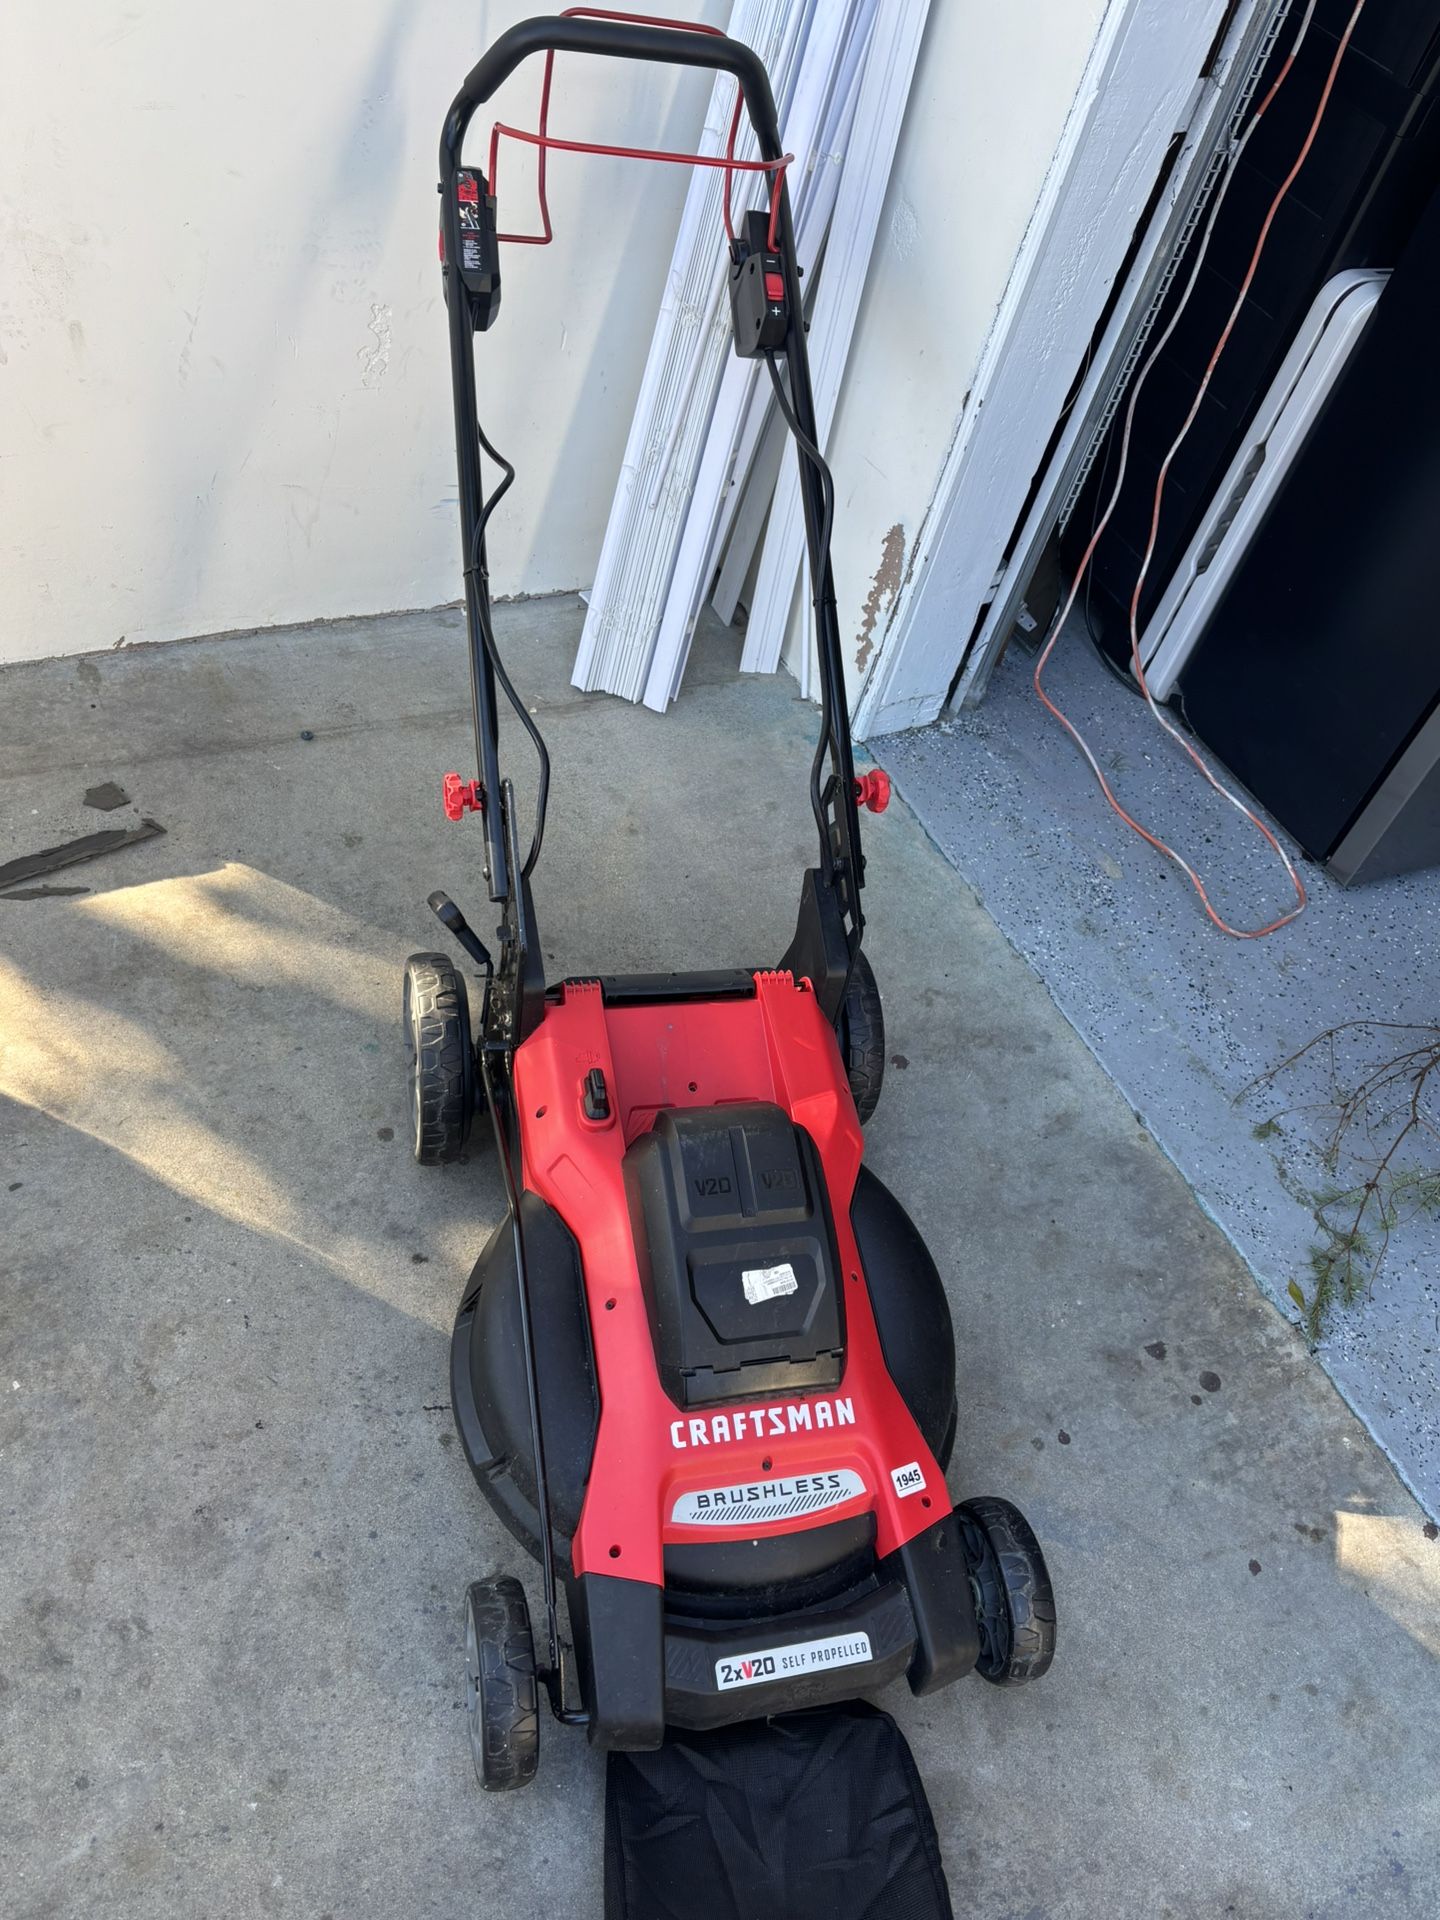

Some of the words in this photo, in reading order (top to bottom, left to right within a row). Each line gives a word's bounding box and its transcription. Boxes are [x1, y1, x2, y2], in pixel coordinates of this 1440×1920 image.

[671, 1397, 856, 1448] CRAFTSMAN
[697, 1474, 841, 1509] BRUSHLESS
[895, 1469, 921, 1489] 1945
[721, 1657, 775, 1683] 2xV20
[782, 1655, 806, 1669] SELF
[810, 1642, 867, 1663] PROPELLED
